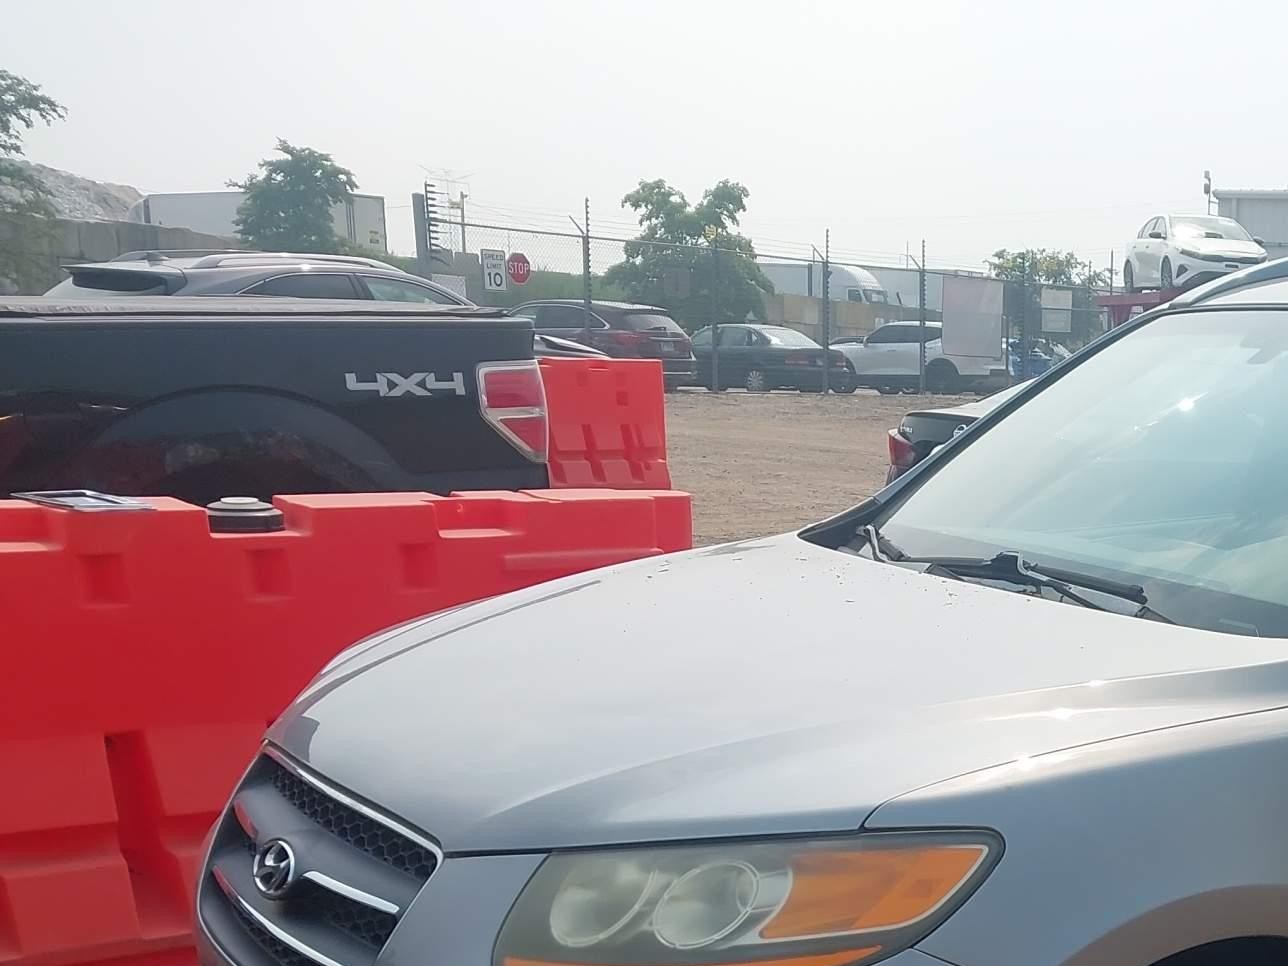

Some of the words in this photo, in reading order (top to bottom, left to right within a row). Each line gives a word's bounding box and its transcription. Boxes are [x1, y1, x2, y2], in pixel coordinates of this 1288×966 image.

[485, 253, 504, 261] SPEED
[508, 262, 529, 274] STOP
[487, 271, 503, 287] 10
